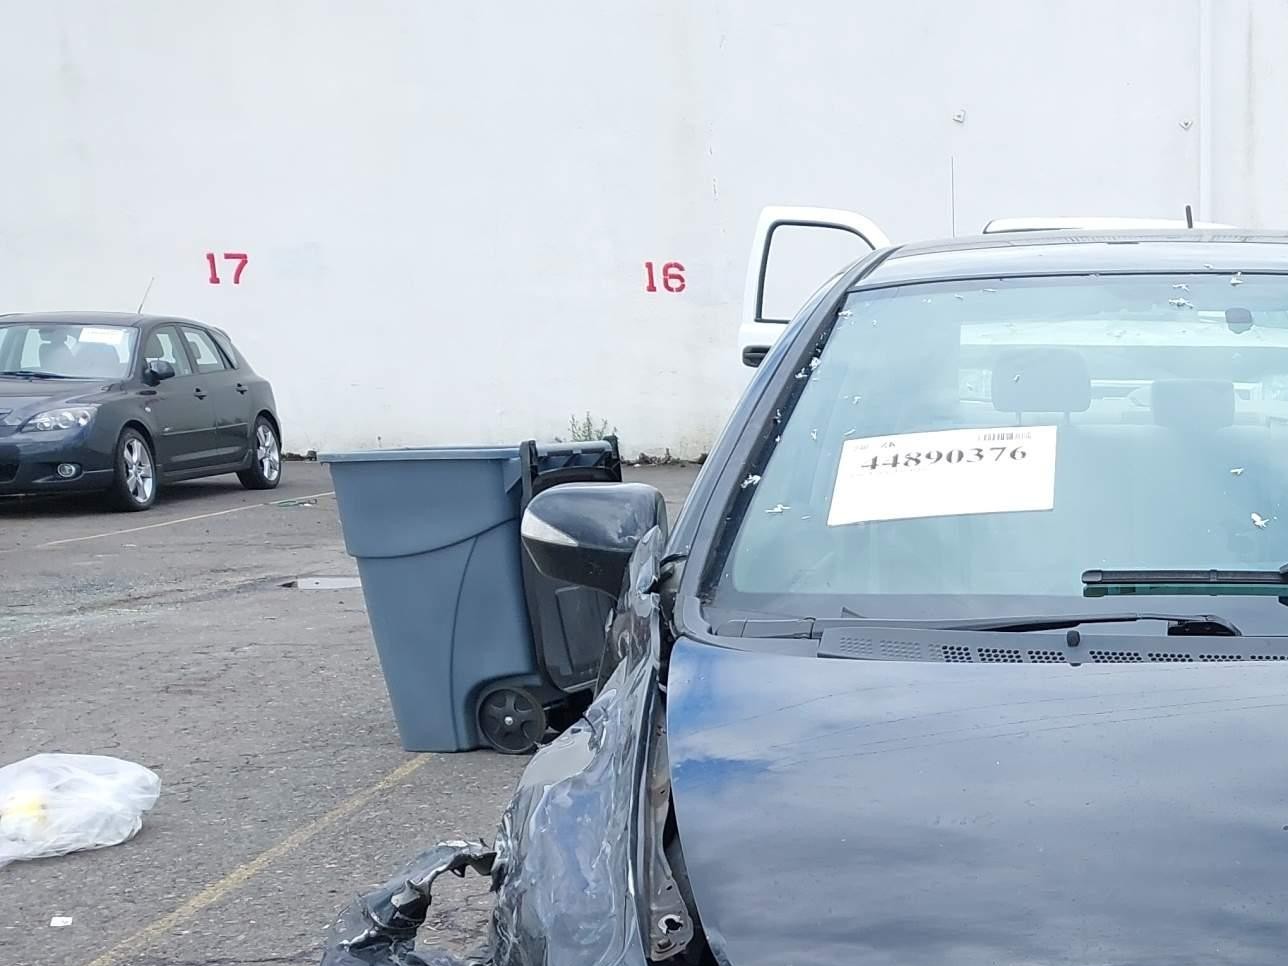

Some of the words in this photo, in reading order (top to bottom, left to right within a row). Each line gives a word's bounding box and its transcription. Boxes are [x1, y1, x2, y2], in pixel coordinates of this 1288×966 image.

[206, 252, 248, 284] 17
[645, 261, 686, 293] 16
[860, 446, 1027, 470] 44890376
